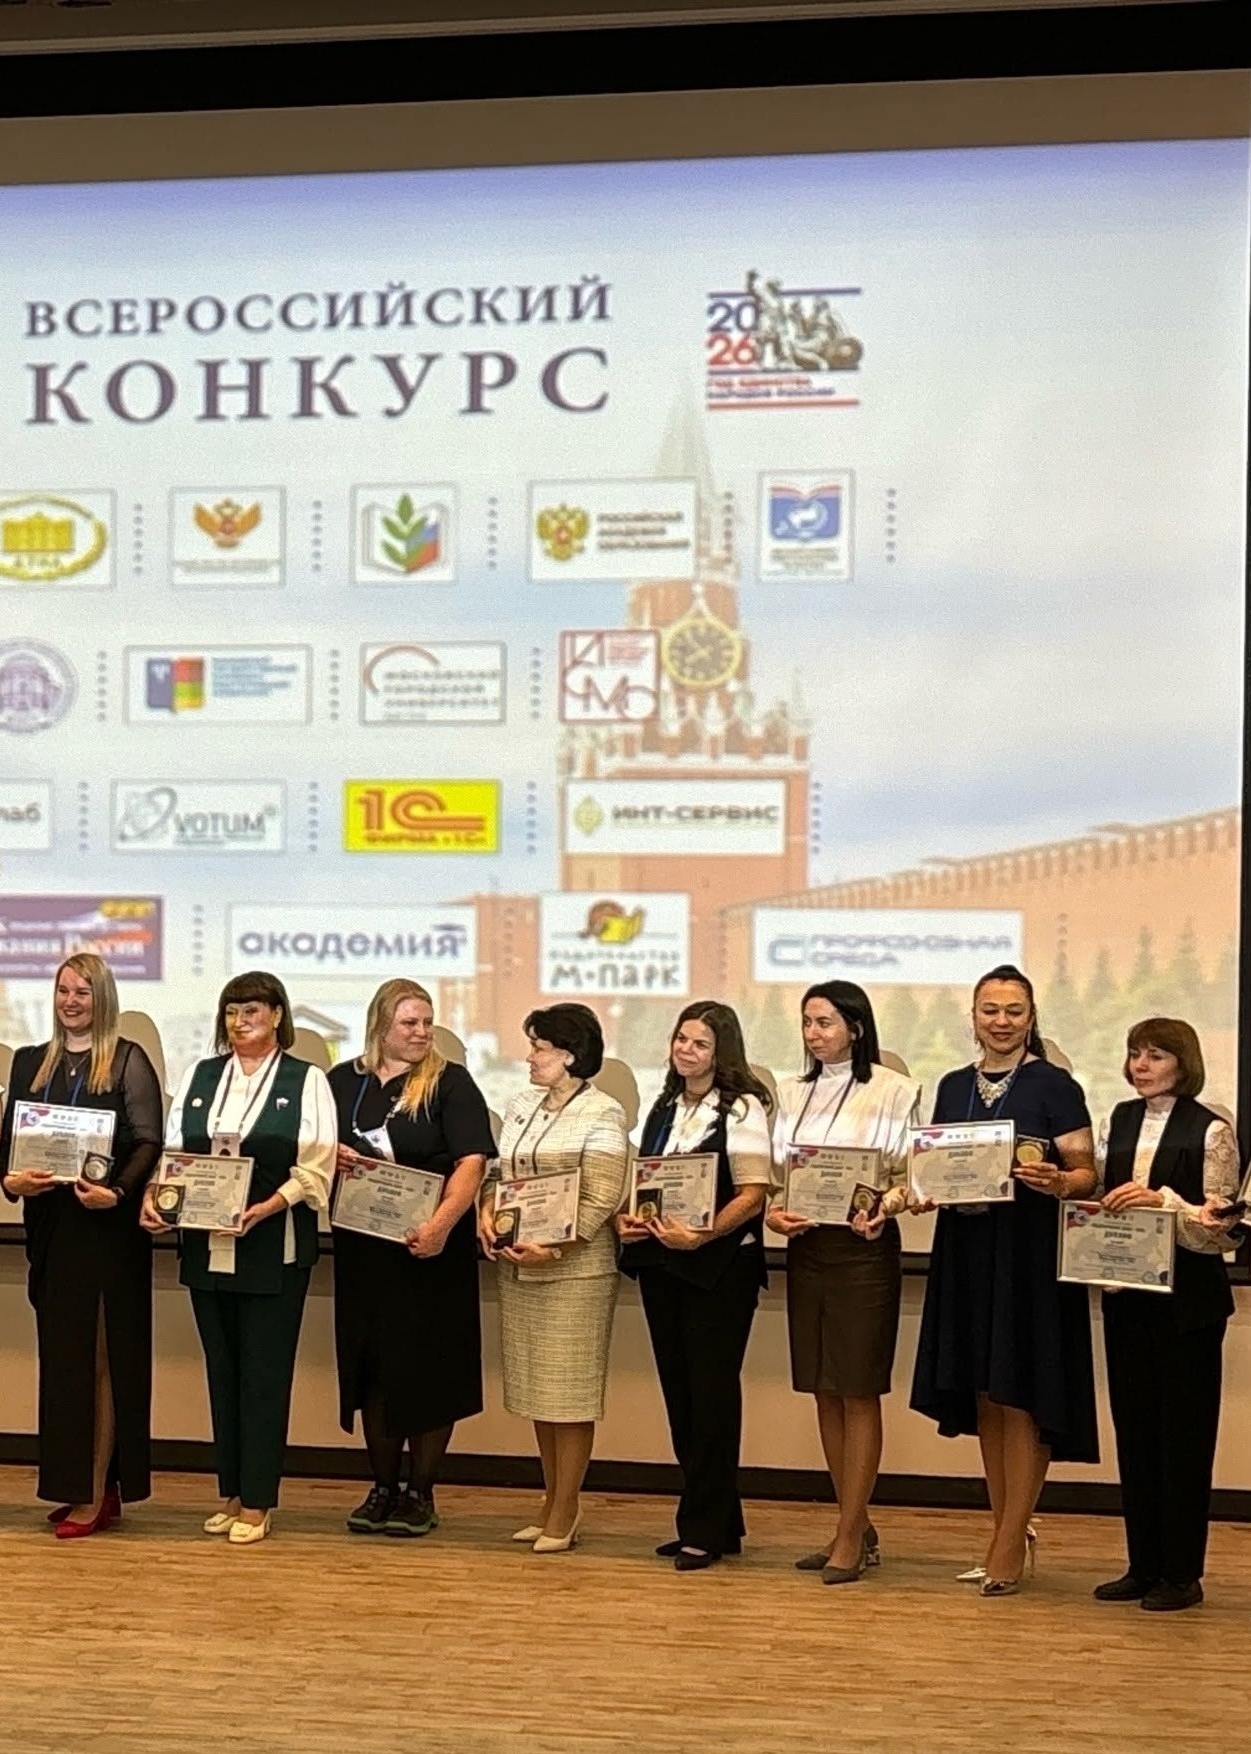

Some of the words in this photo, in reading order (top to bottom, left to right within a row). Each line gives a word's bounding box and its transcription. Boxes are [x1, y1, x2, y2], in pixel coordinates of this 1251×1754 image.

[25, 276, 612, 338] ВСЕРОССИЙСКИЙ
[706, 301, 761, 332] 20
[706, 333, 759, 366] 26
[25, 346, 611, 426] КОНКУРС
[611, 803, 780, 823] ИНТ-СЕРВИС
